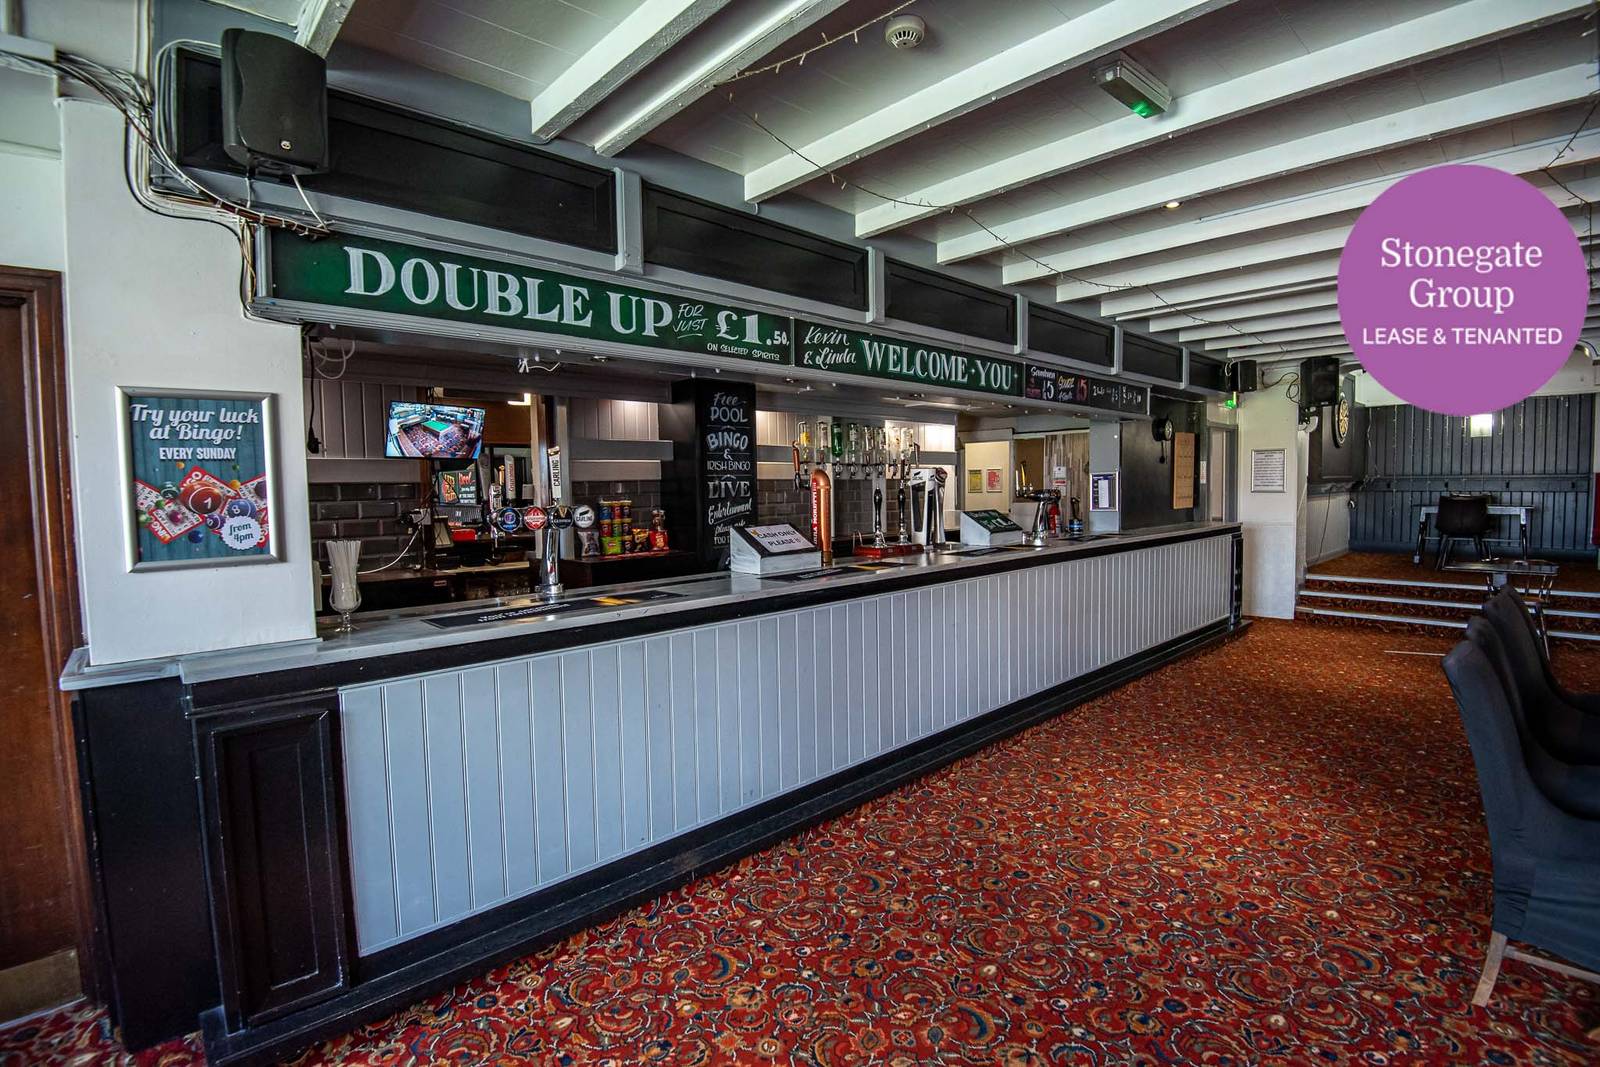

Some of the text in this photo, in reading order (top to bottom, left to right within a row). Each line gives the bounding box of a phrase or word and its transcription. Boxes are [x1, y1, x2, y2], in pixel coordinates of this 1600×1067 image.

[343, 246, 673, 338] DOUBLE UP
[678, 303, 704, 319] FOR
[673, 318, 709, 332] JUST
[803, 326, 850, 346] Kevin
[706, 342, 780, 360] ON SELECTED SPIRITS
[803, 347, 857, 370] & Linda
[861, 339, 968, 387] WELCOME
[974, 358, 1014, 391] YOU
[713, 392, 743, 406] Free
[131, 404, 259, 427] Try your luck
[710, 406, 749, 423] POOL
[150, 423, 242, 444] at Bingo!
[706, 431, 749, 450] BINGO
[159, 447, 236, 460] EVERY SUNDAY
[552, 460, 560, 487] CARLING
[707, 460, 750, 471] IRISH BINGO
[708, 480, 750, 499] LIVE
[229, 523, 252, 535] from
[233, 532, 254, 543] 4pm
